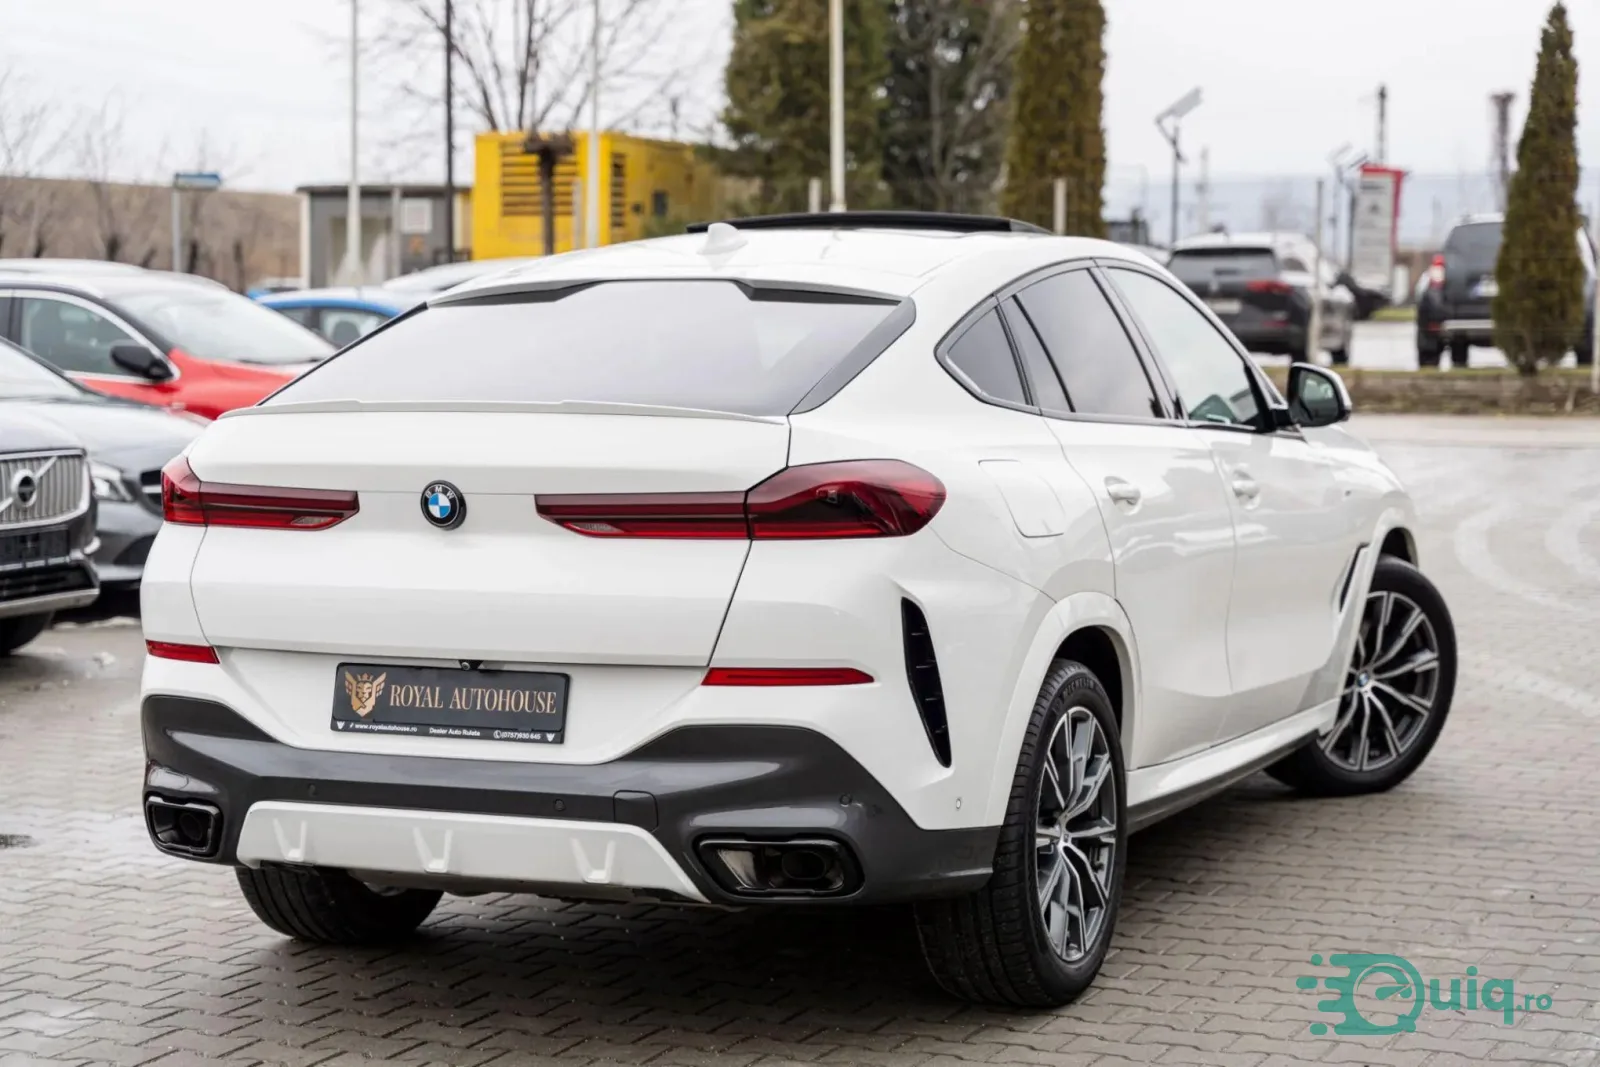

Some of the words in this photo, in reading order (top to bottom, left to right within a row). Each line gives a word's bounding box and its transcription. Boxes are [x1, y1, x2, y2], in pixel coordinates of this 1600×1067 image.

[425, 485, 455, 499] BMW
[389, 684, 444, 709] ROYAL
[449, 688, 557, 714] AUTOHOUSE
[354, 723, 418, 733] www.royalautohouse.ro
[429, 727, 448, 735] Dealer
[448, 728, 462, 736] Auto
[463, 729, 481, 737] Rulate
